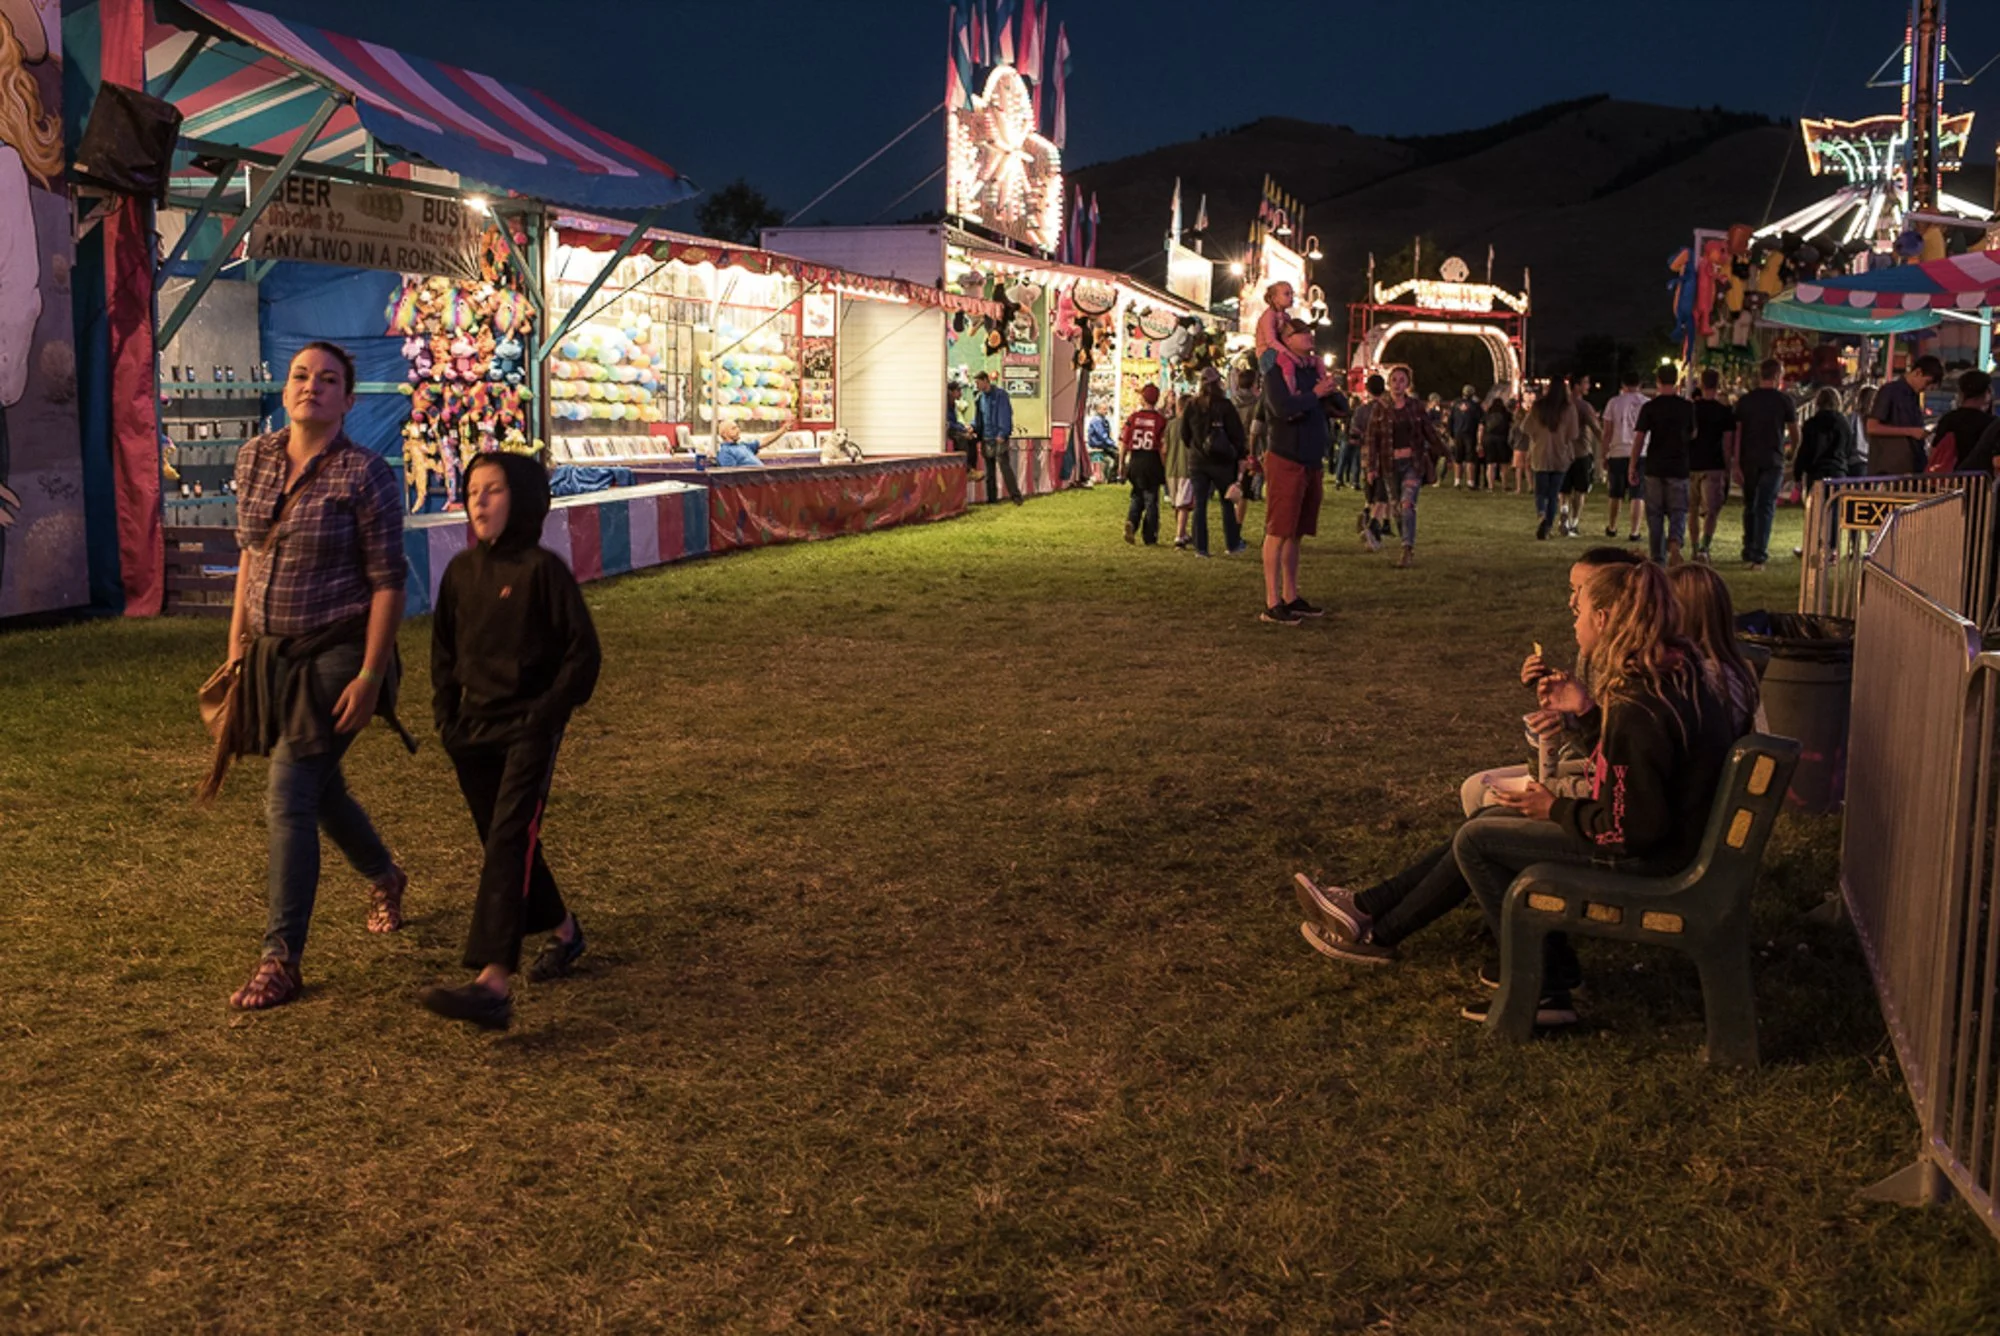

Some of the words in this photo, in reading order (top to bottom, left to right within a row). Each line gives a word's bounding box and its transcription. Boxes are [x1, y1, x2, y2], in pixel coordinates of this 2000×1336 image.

[262, 232, 302, 257] ANY
[310, 236, 352, 262] TWO
[357, 241, 378, 265] IN
[380, 244, 391, 267] A
[1132, 429, 1154, 450] 56
[1854, 502, 1903, 524] EX
